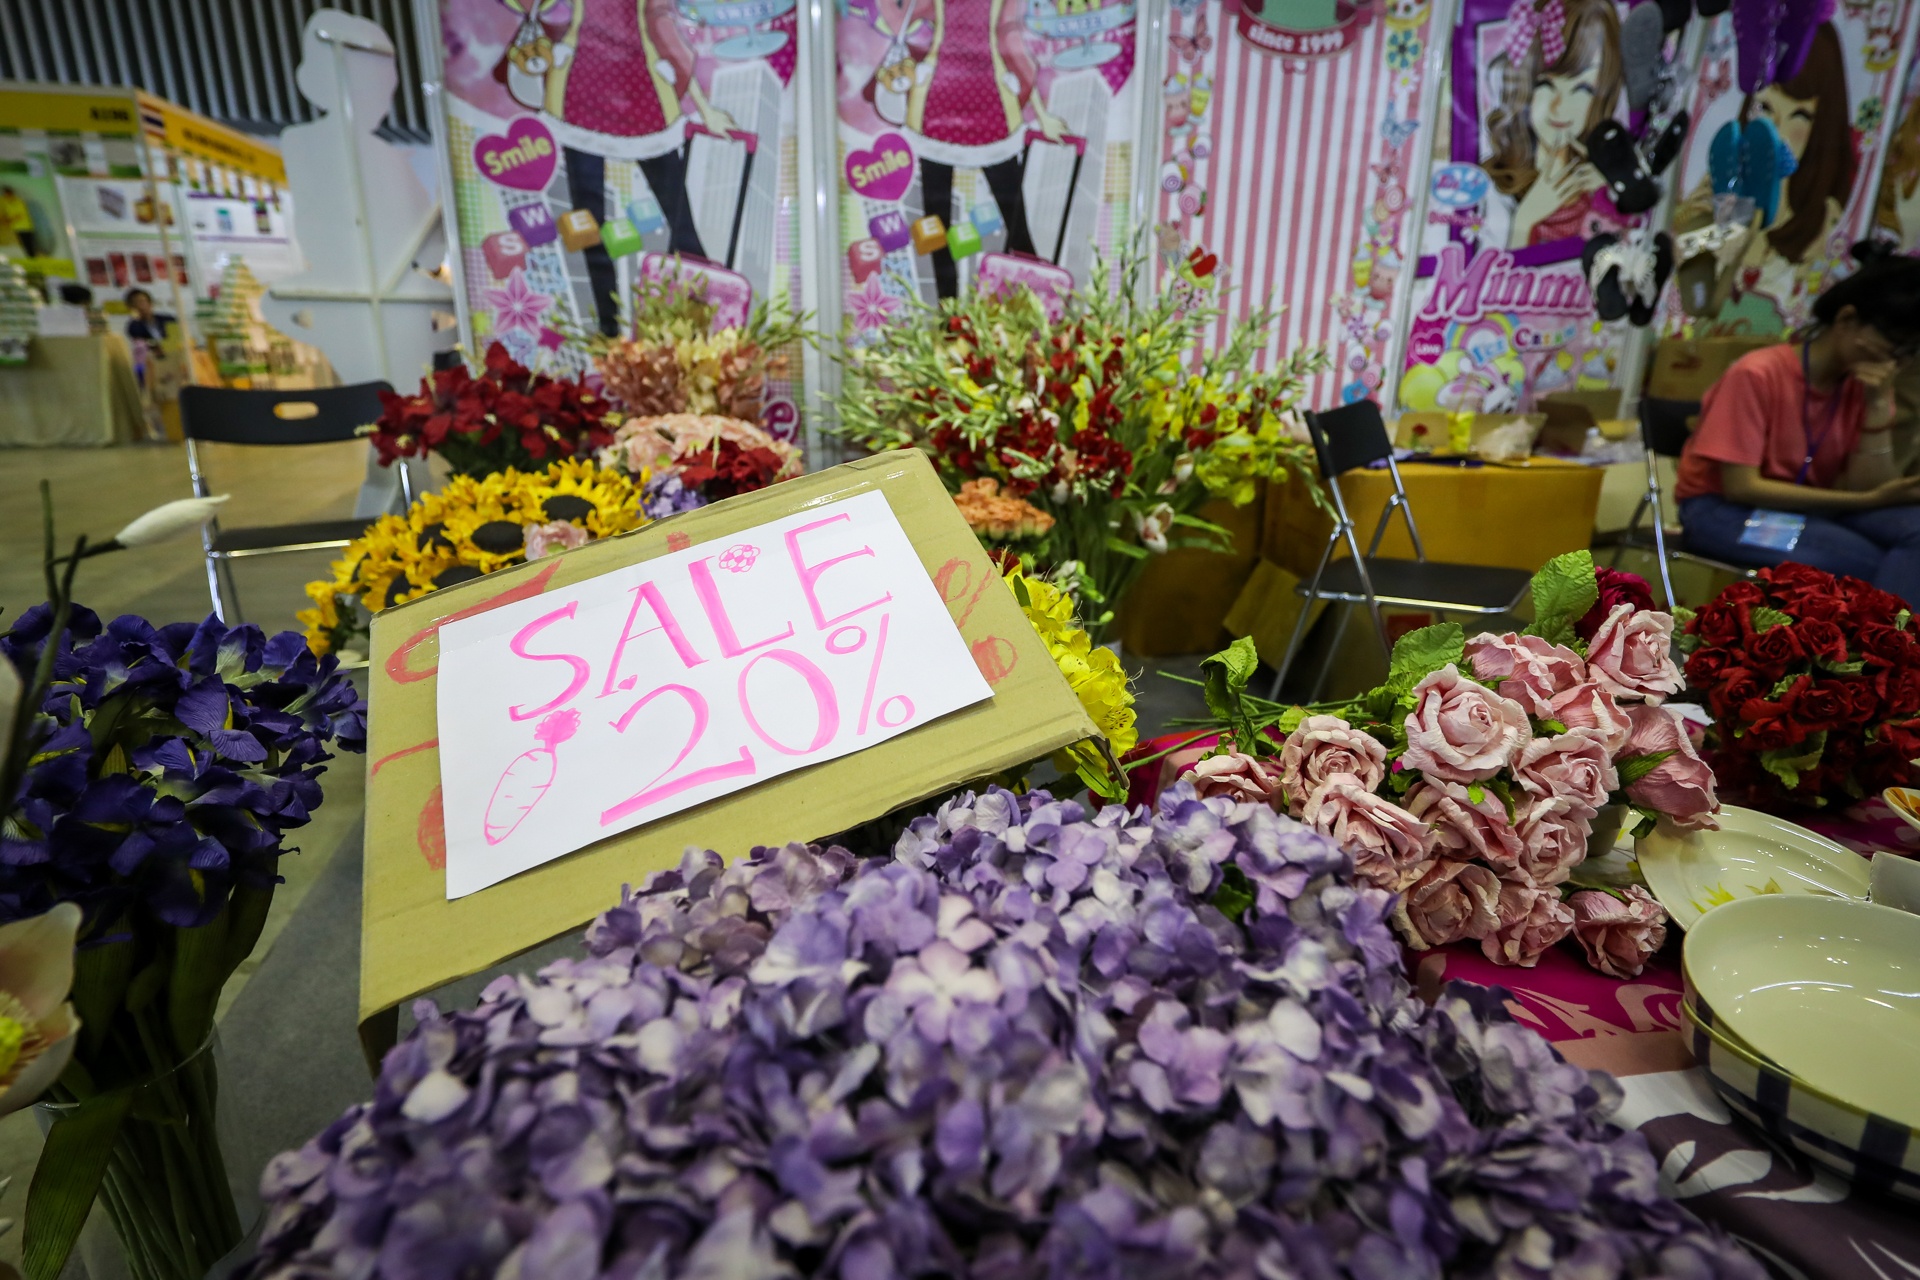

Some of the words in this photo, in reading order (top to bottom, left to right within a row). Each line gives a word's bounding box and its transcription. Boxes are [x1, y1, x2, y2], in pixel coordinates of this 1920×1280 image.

[1248, 24, 1295, 51] since
[1300, 30, 1344, 53] 1999
[484, 136, 553, 177] Smile
[851, 149, 911, 188] Smile
[508, 512, 894, 722] SALE
[600, 612, 916, 827] 20%
